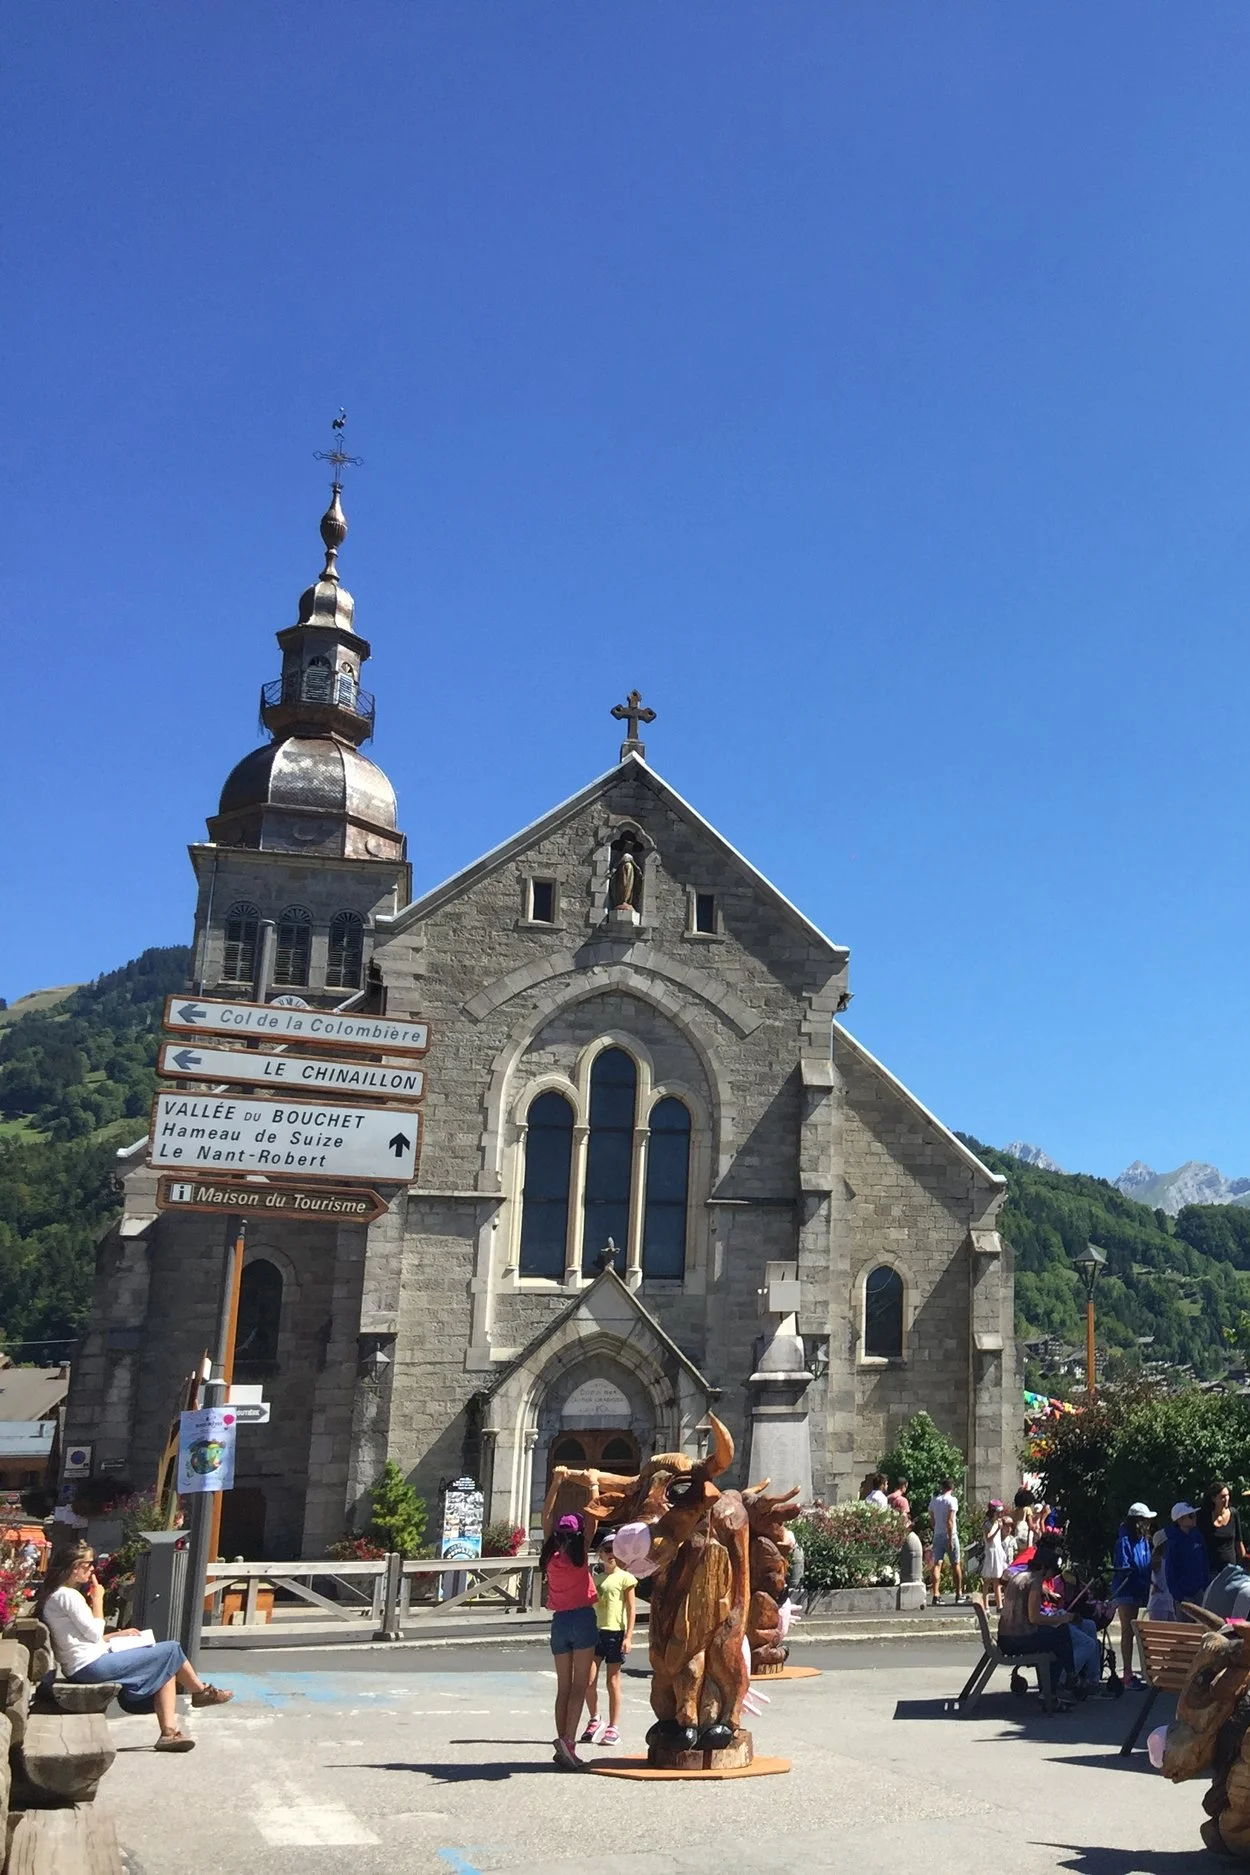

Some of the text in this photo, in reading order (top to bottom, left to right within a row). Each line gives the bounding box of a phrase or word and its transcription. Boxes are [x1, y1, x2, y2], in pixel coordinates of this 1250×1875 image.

[219, 1008, 422, 1043] Col de la Colombière
[264, 1061, 417, 1090] LE CHINAILLON
[164, 1101, 366, 1129] VALLÉE DU BOUCHET
[161, 1122, 344, 1148] Hameau de Suize
[159, 1143, 327, 1168] Le Nant-Robert
[196, 1187, 259, 1207] Maison
[265, 1192, 287, 1208] du
[292, 1195, 367, 1214] Tourisme
